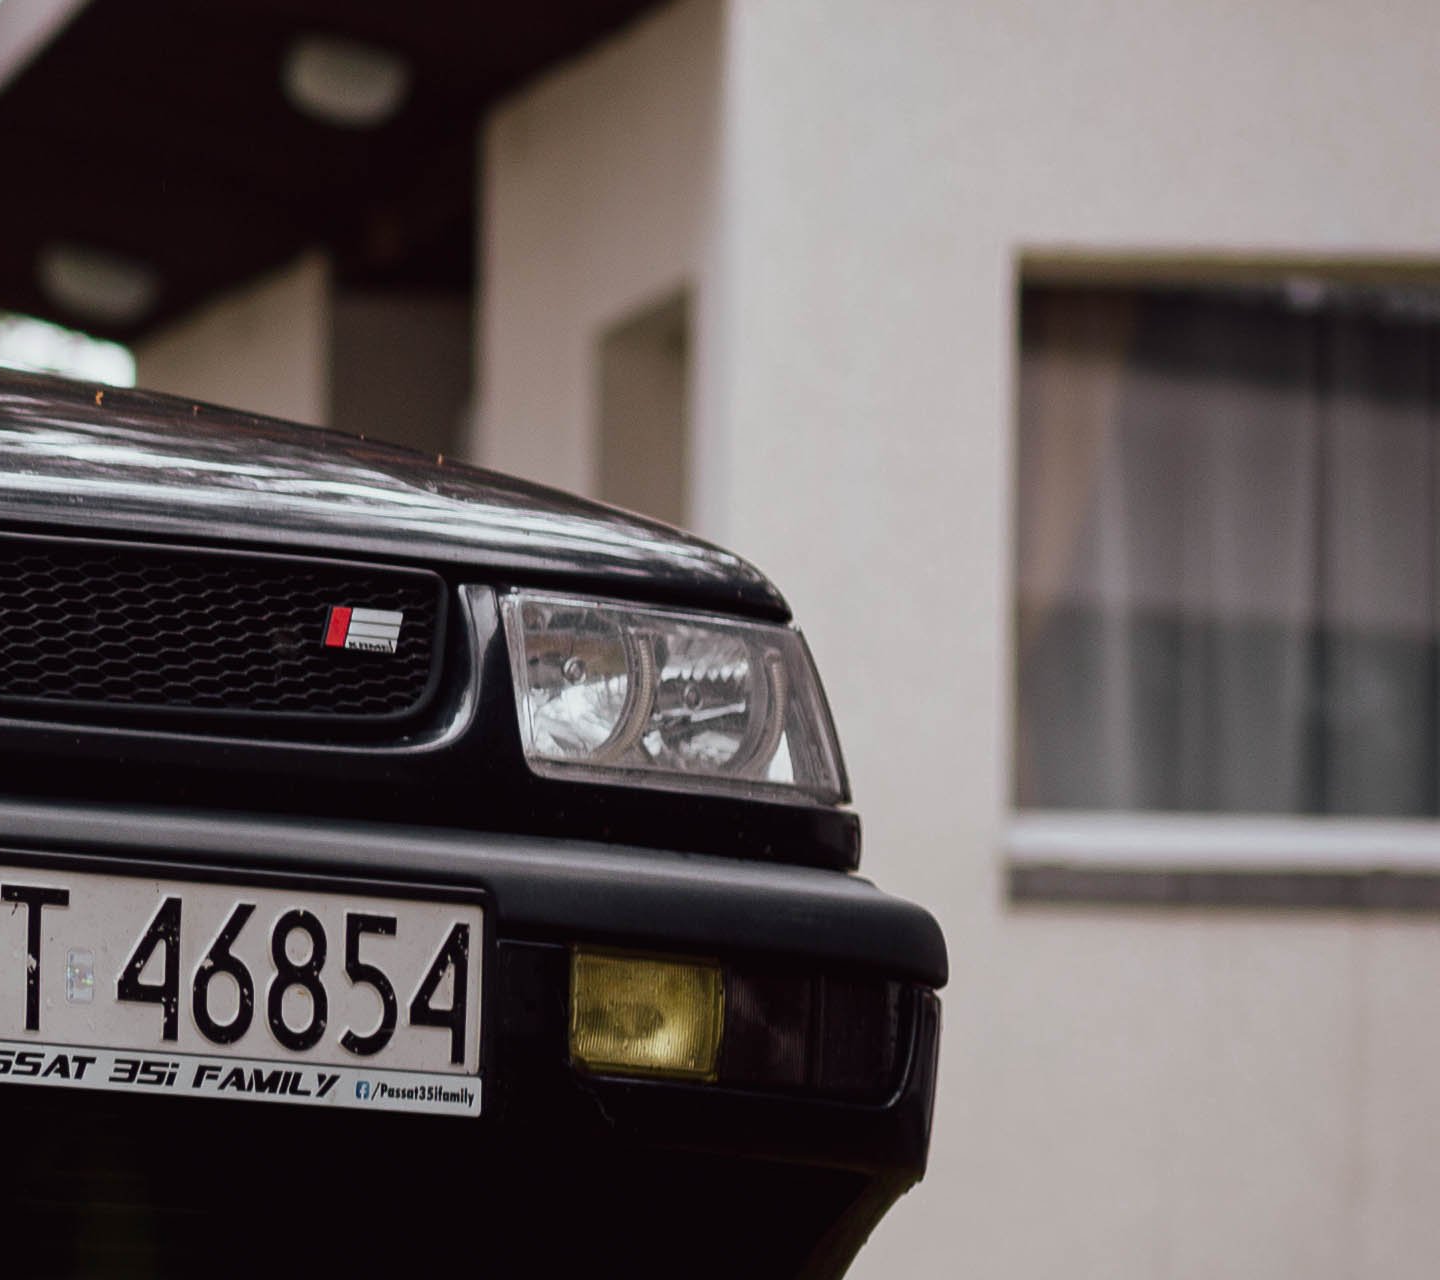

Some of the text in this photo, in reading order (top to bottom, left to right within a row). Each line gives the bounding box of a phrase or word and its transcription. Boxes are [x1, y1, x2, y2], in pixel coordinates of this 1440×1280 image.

[116, 896, 472, 1065] 46854
[108, 1058, 180, 1087] 35i
[191, 1064, 341, 1099] FAMILY
